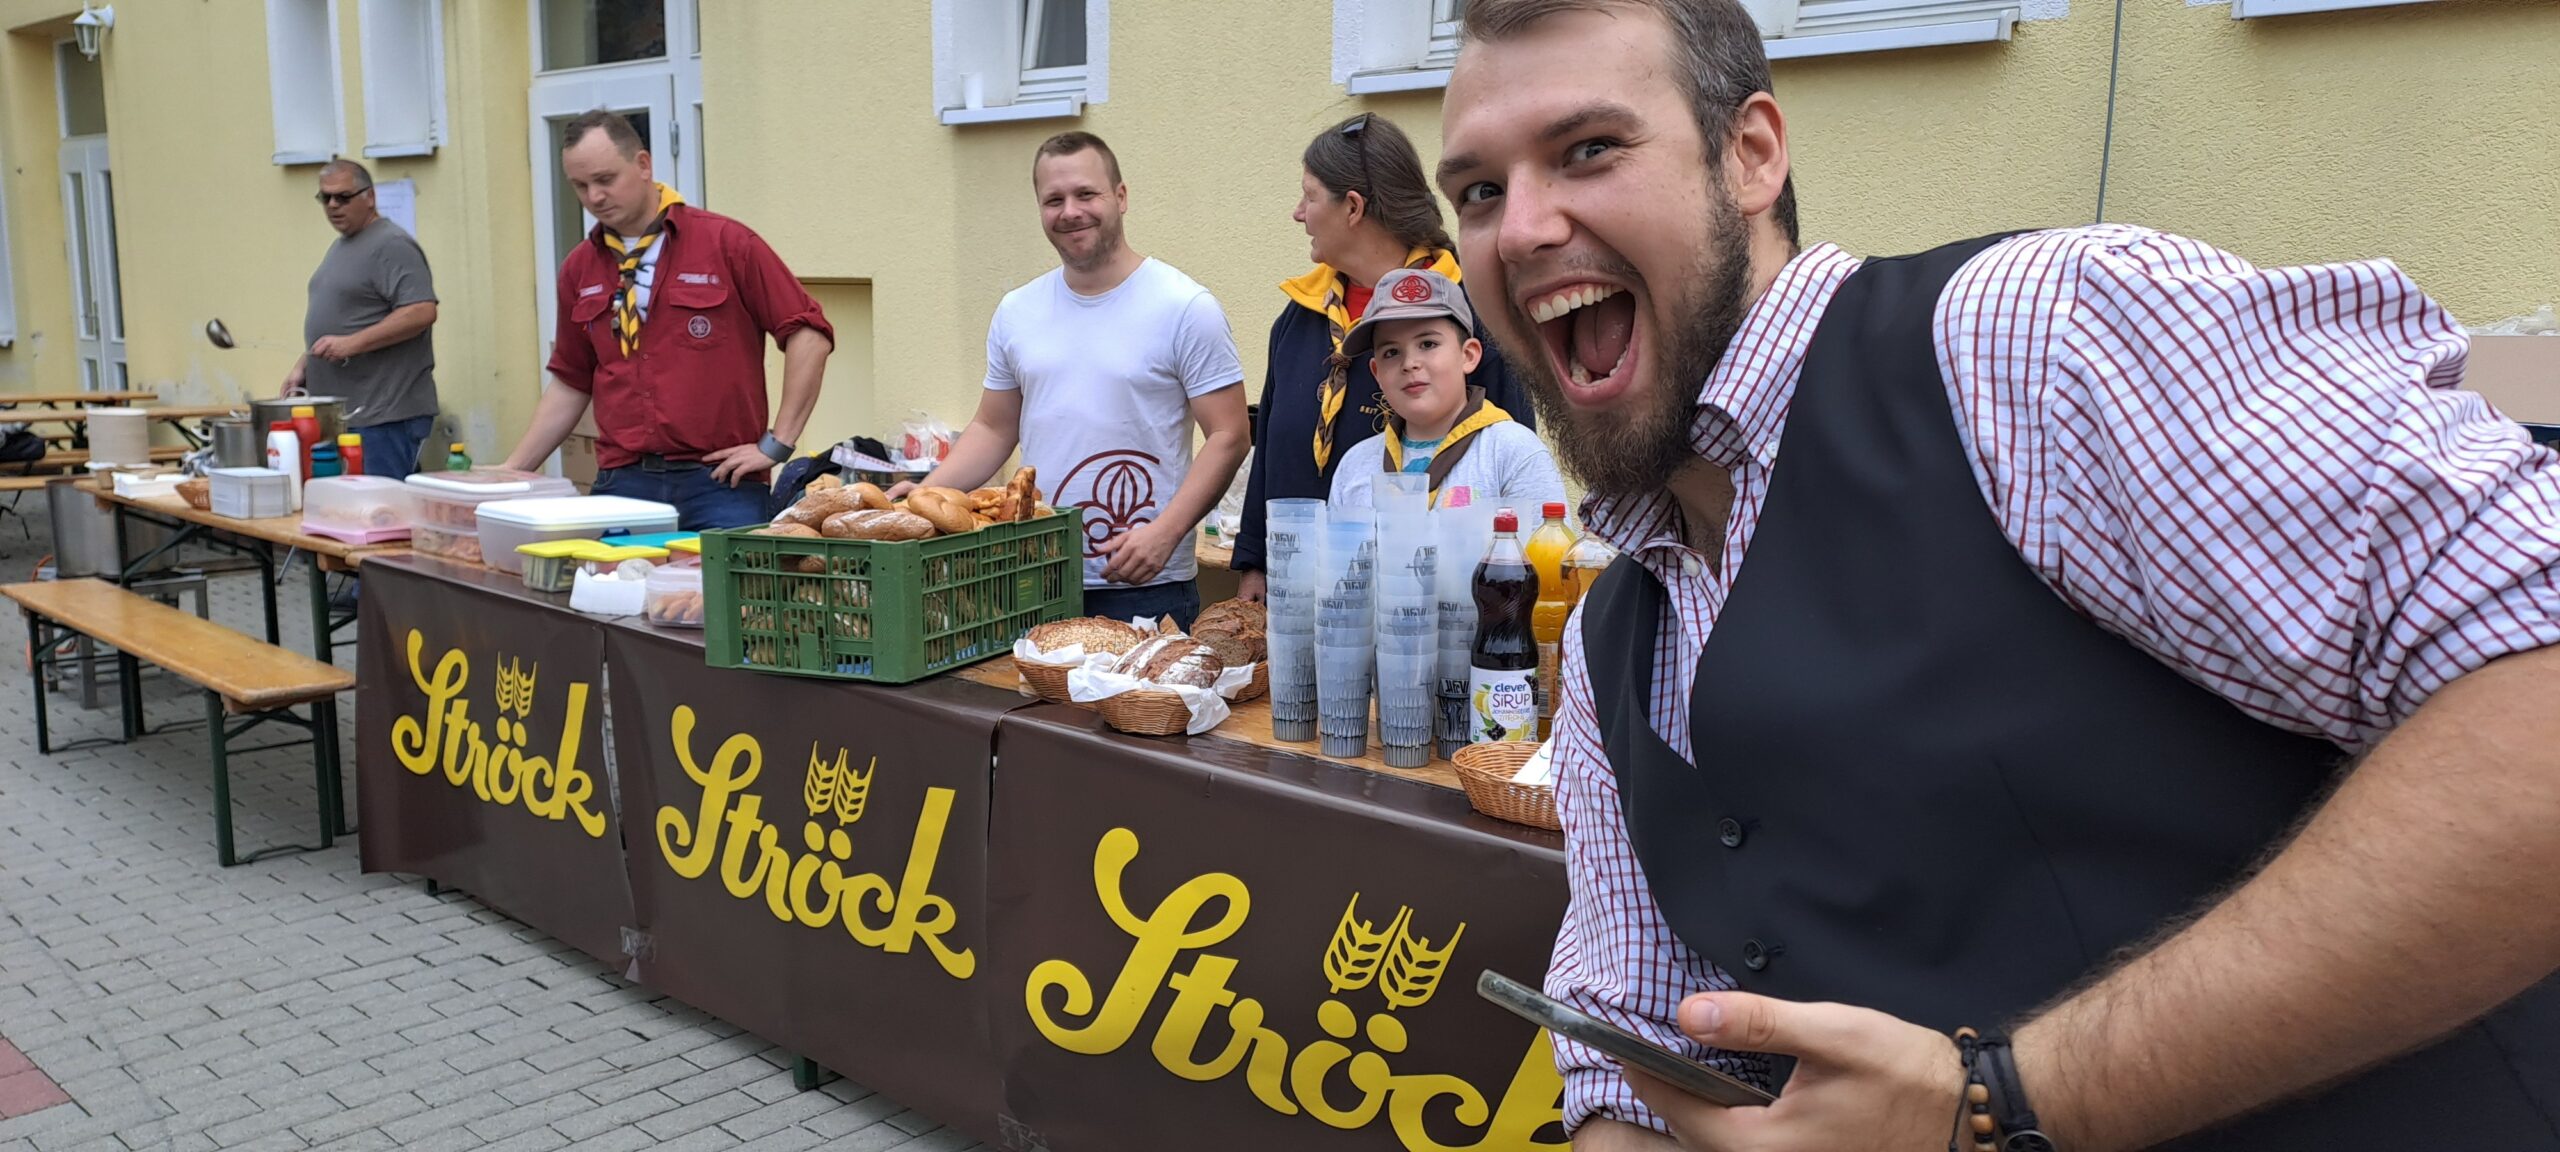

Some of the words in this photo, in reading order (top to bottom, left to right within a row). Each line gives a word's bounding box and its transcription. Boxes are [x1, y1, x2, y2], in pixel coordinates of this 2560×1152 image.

[391, 628, 606, 838] Ströck
[1495, 683, 1527, 693] clever
[656, 705, 976, 979] Ströck
